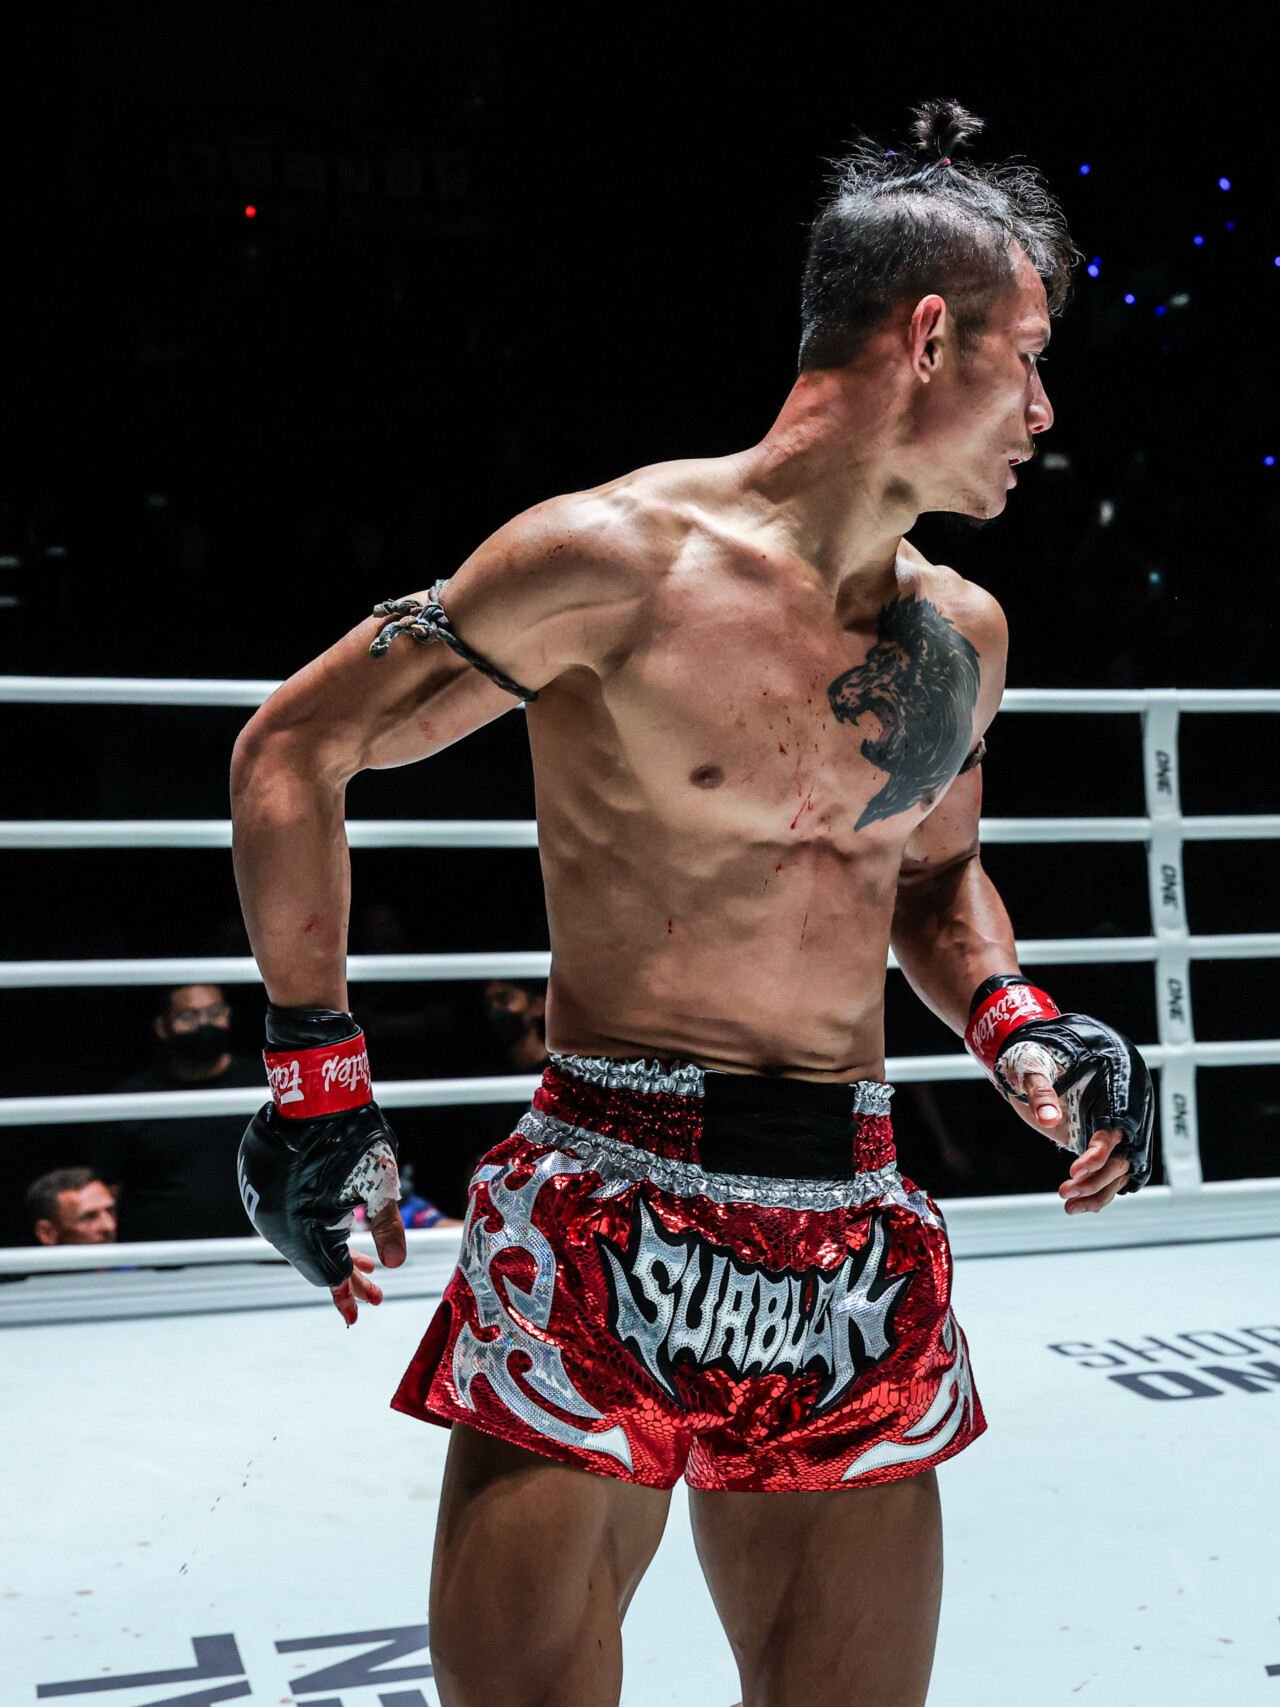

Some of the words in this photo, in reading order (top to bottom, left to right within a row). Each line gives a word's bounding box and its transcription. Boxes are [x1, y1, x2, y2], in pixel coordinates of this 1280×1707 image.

[1156, 750, 1172, 796] ONE
[1161, 864, 1179, 912] ONE
[1167, 978, 1185, 1025] ONE
[1172, 1093, 1190, 1139] ONE
[237, 1154, 260, 1221] ON
